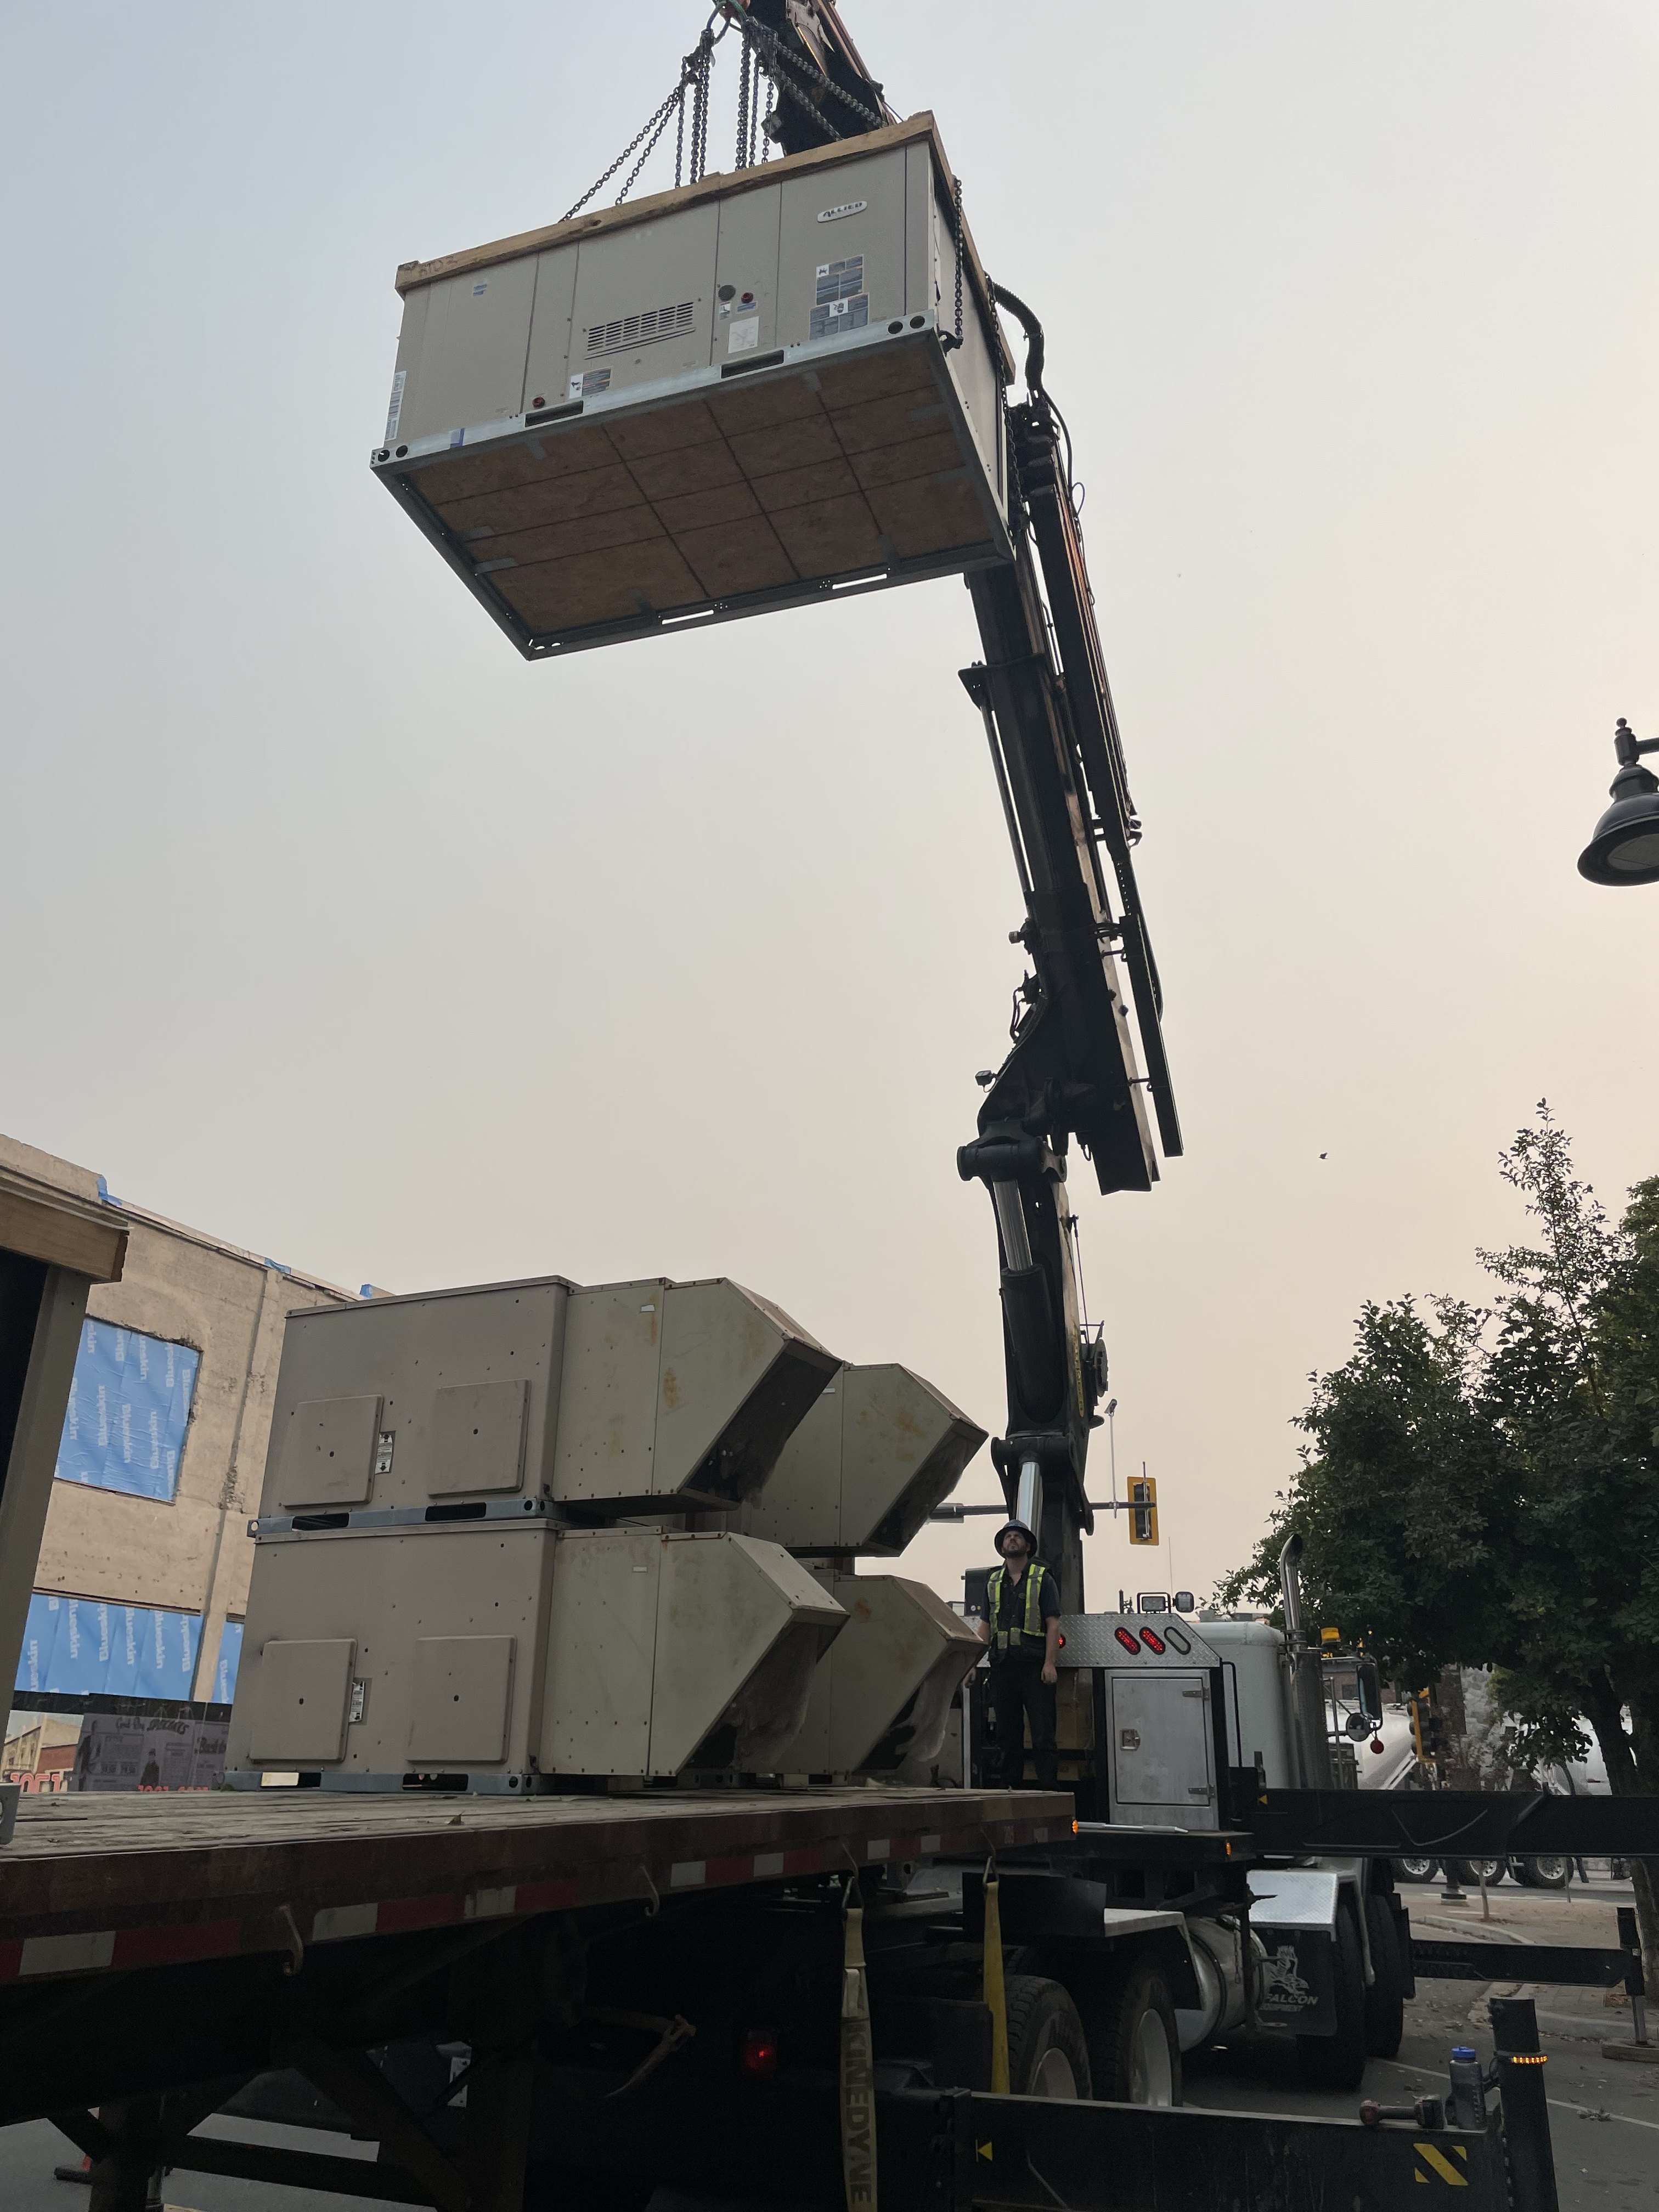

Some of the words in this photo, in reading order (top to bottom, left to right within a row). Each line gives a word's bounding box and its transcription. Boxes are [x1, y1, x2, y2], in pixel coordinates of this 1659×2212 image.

[115, 1329, 124, 1361] Blue
[139, 1336, 149, 1380] ueskin
[165, 1343, 174, 1387] Bluesk
[27, 1640, 38, 1691] ueskin
[845, 2022, 872, 2203] KINEDYNE
